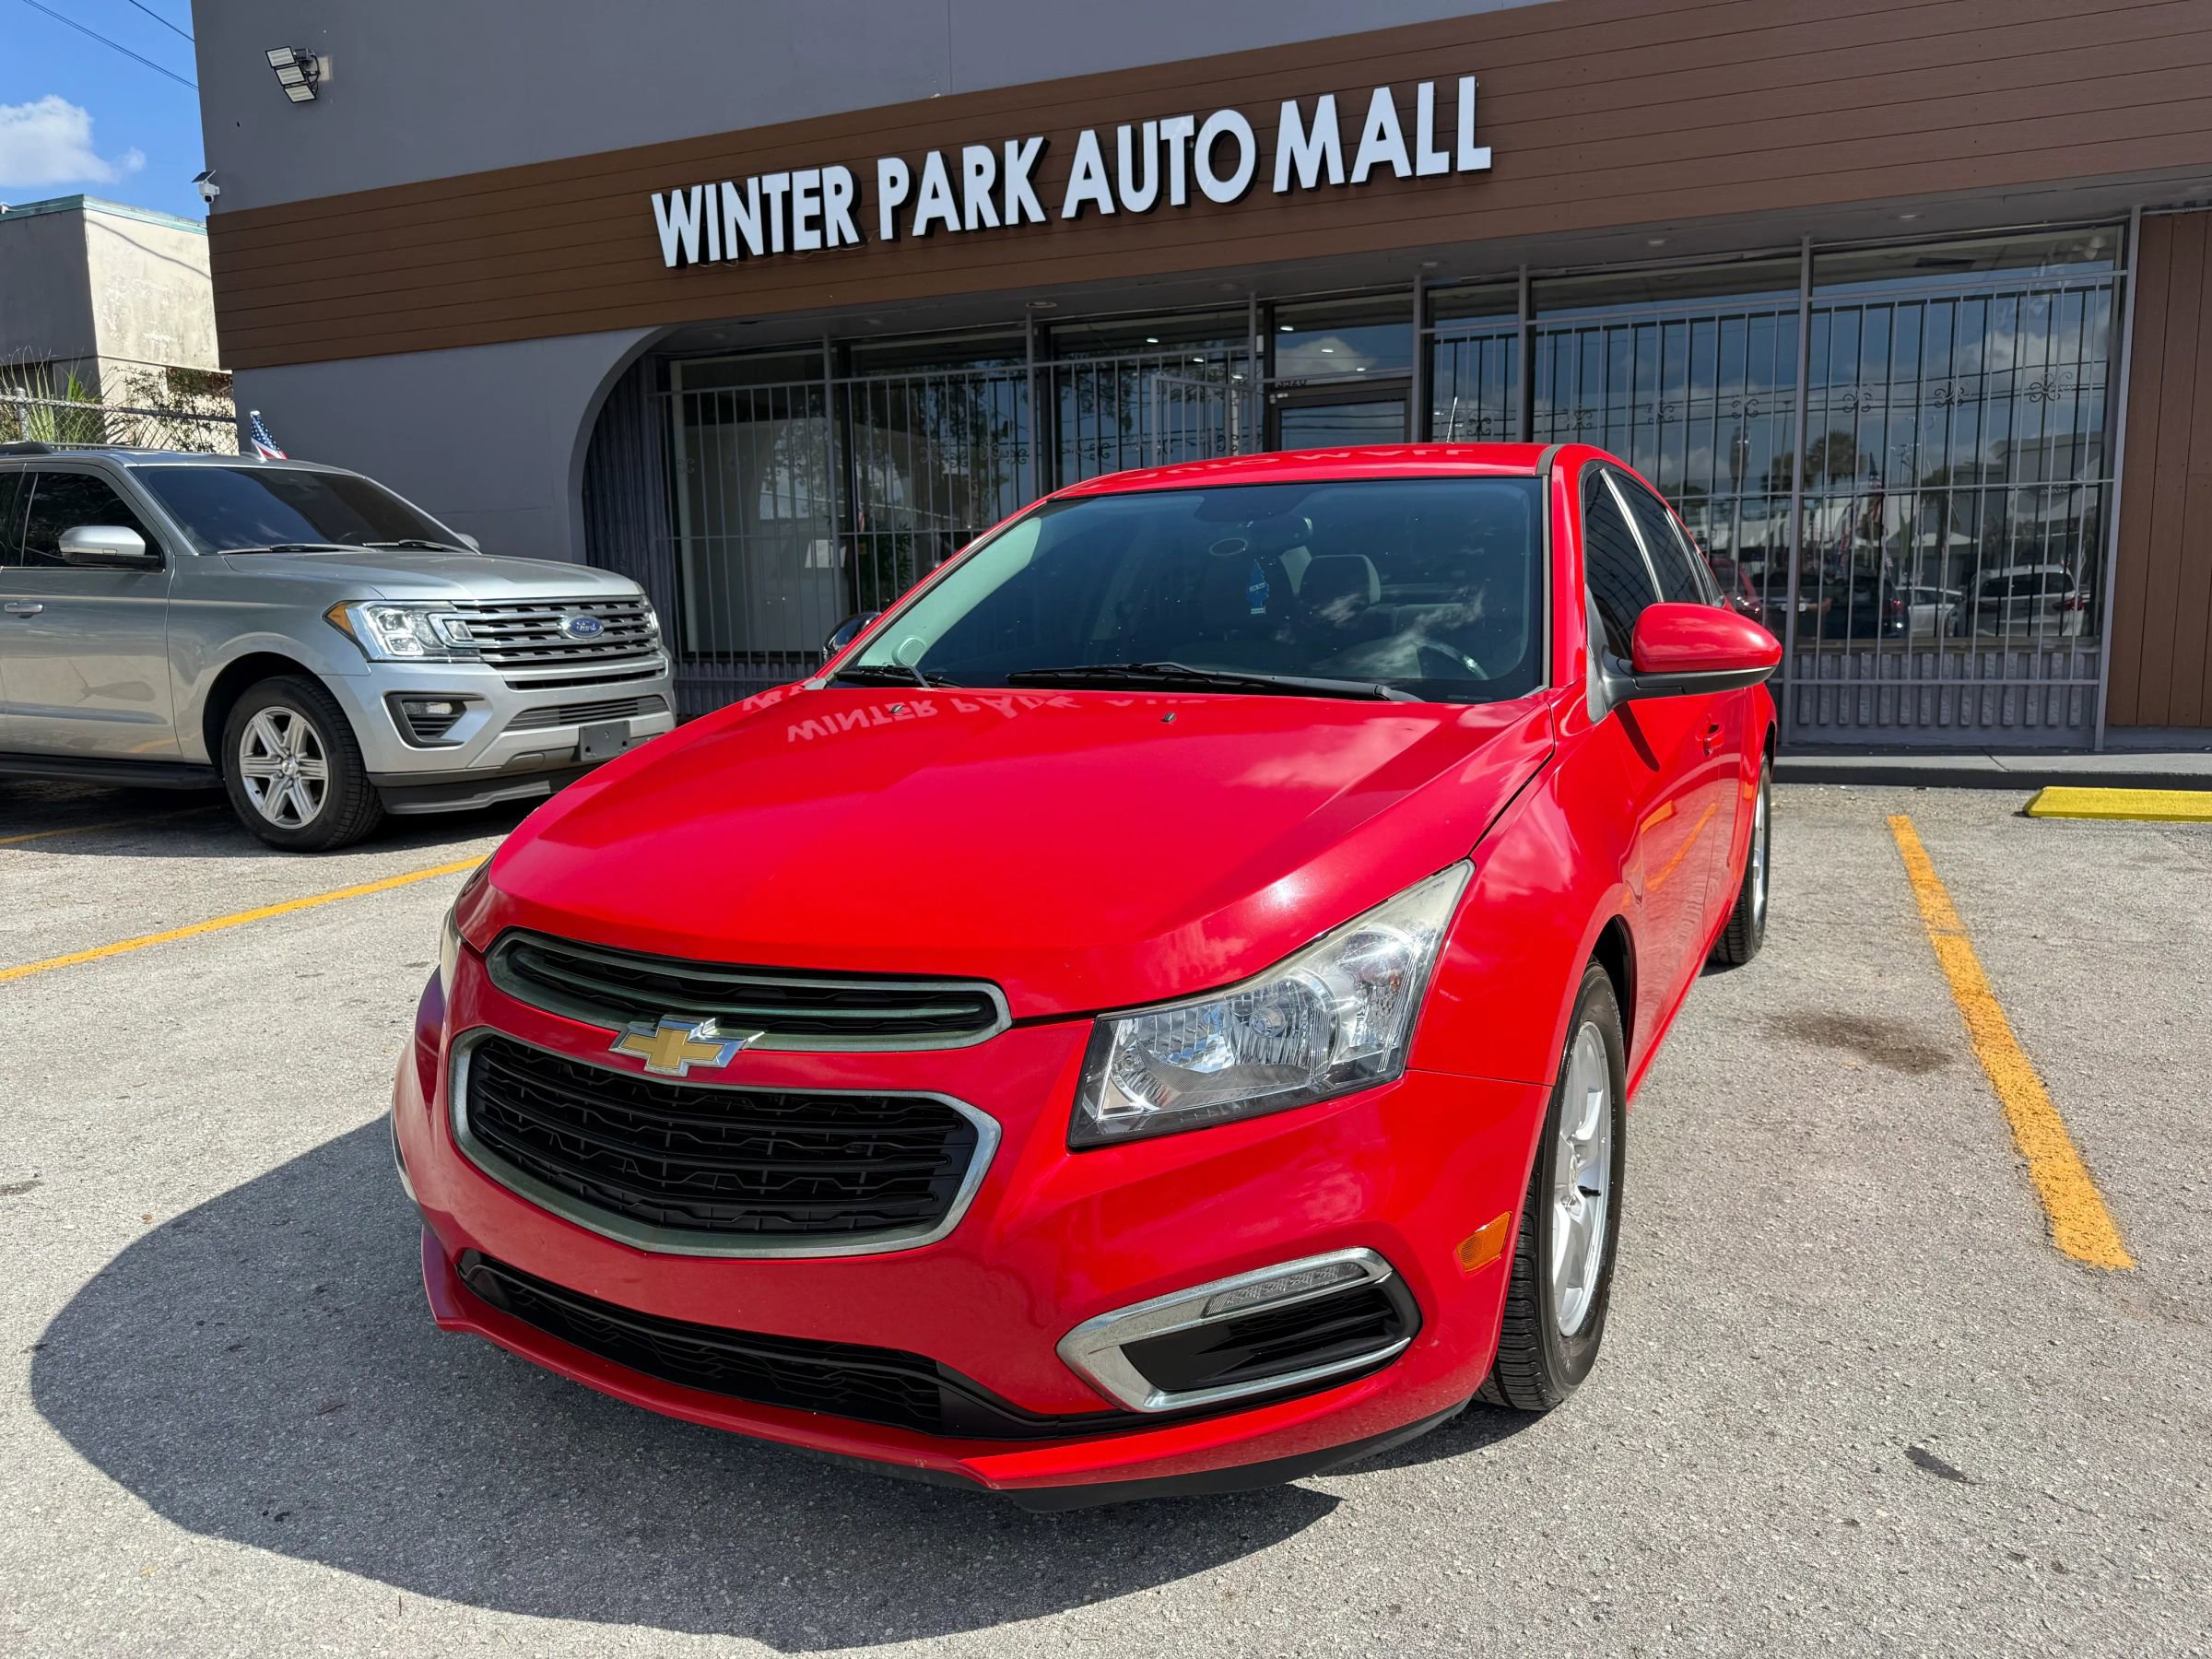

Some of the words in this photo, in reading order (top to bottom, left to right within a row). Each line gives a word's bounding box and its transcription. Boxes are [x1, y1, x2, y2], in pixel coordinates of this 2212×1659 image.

[651, 165, 860, 267] WINTER
[877, 136, 1047, 241] PARK
[1061, 109, 1255, 218] AUTO
[1273, 76, 1491, 193] MALL
